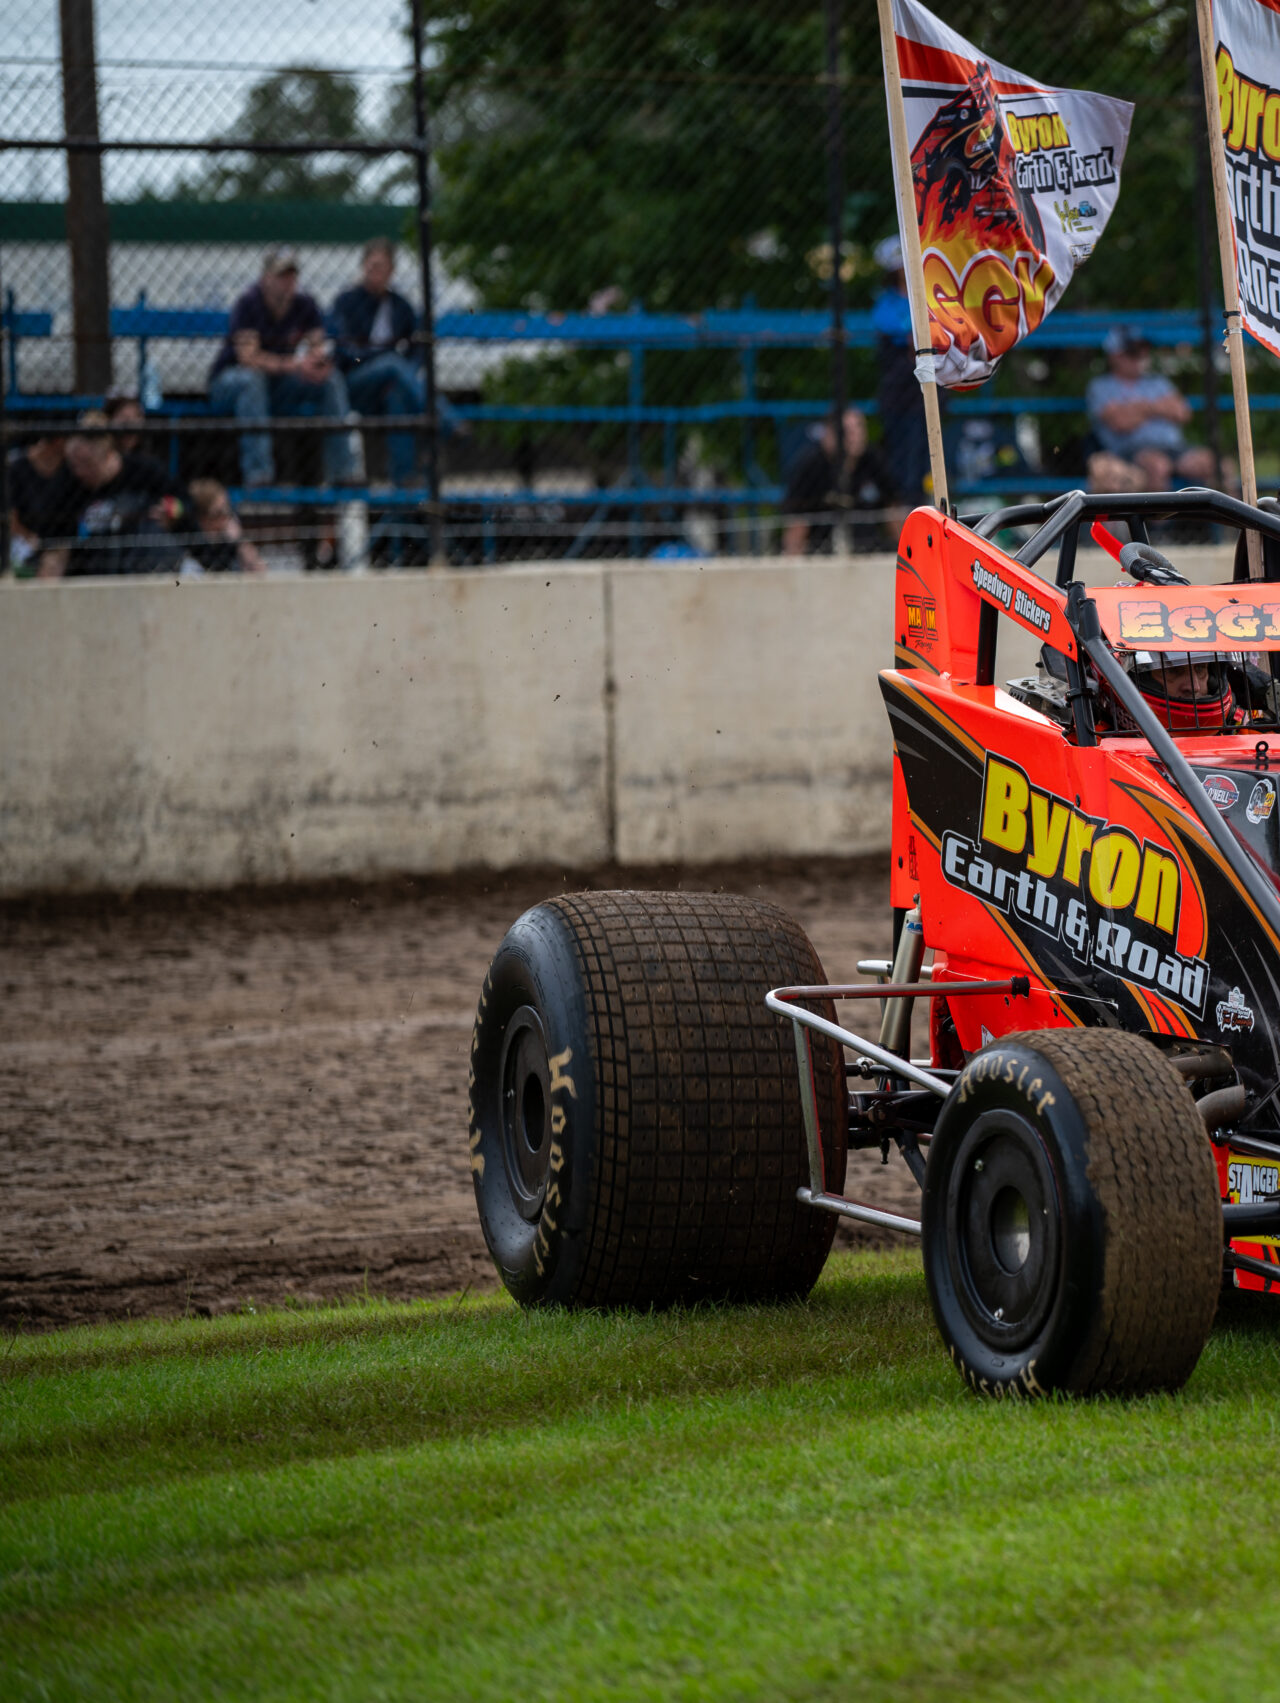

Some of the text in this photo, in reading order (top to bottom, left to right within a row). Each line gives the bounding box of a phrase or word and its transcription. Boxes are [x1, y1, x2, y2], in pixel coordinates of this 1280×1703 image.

[1007, 112, 1070, 155] Byron
[1016, 154, 1053, 189] Earth
[1054, 154, 1069, 190] &
[973, 560, 1051, 633] Speedway Stickers
[982, 757, 1179, 936] Byron
[944, 837, 1059, 928] Earth
[1065, 898, 1090, 953] &
[1095, 918, 1204, 1009] Road
[957, 1055, 1056, 1116] Hoosier
[1228, 1163, 1279, 1204] STANGER
